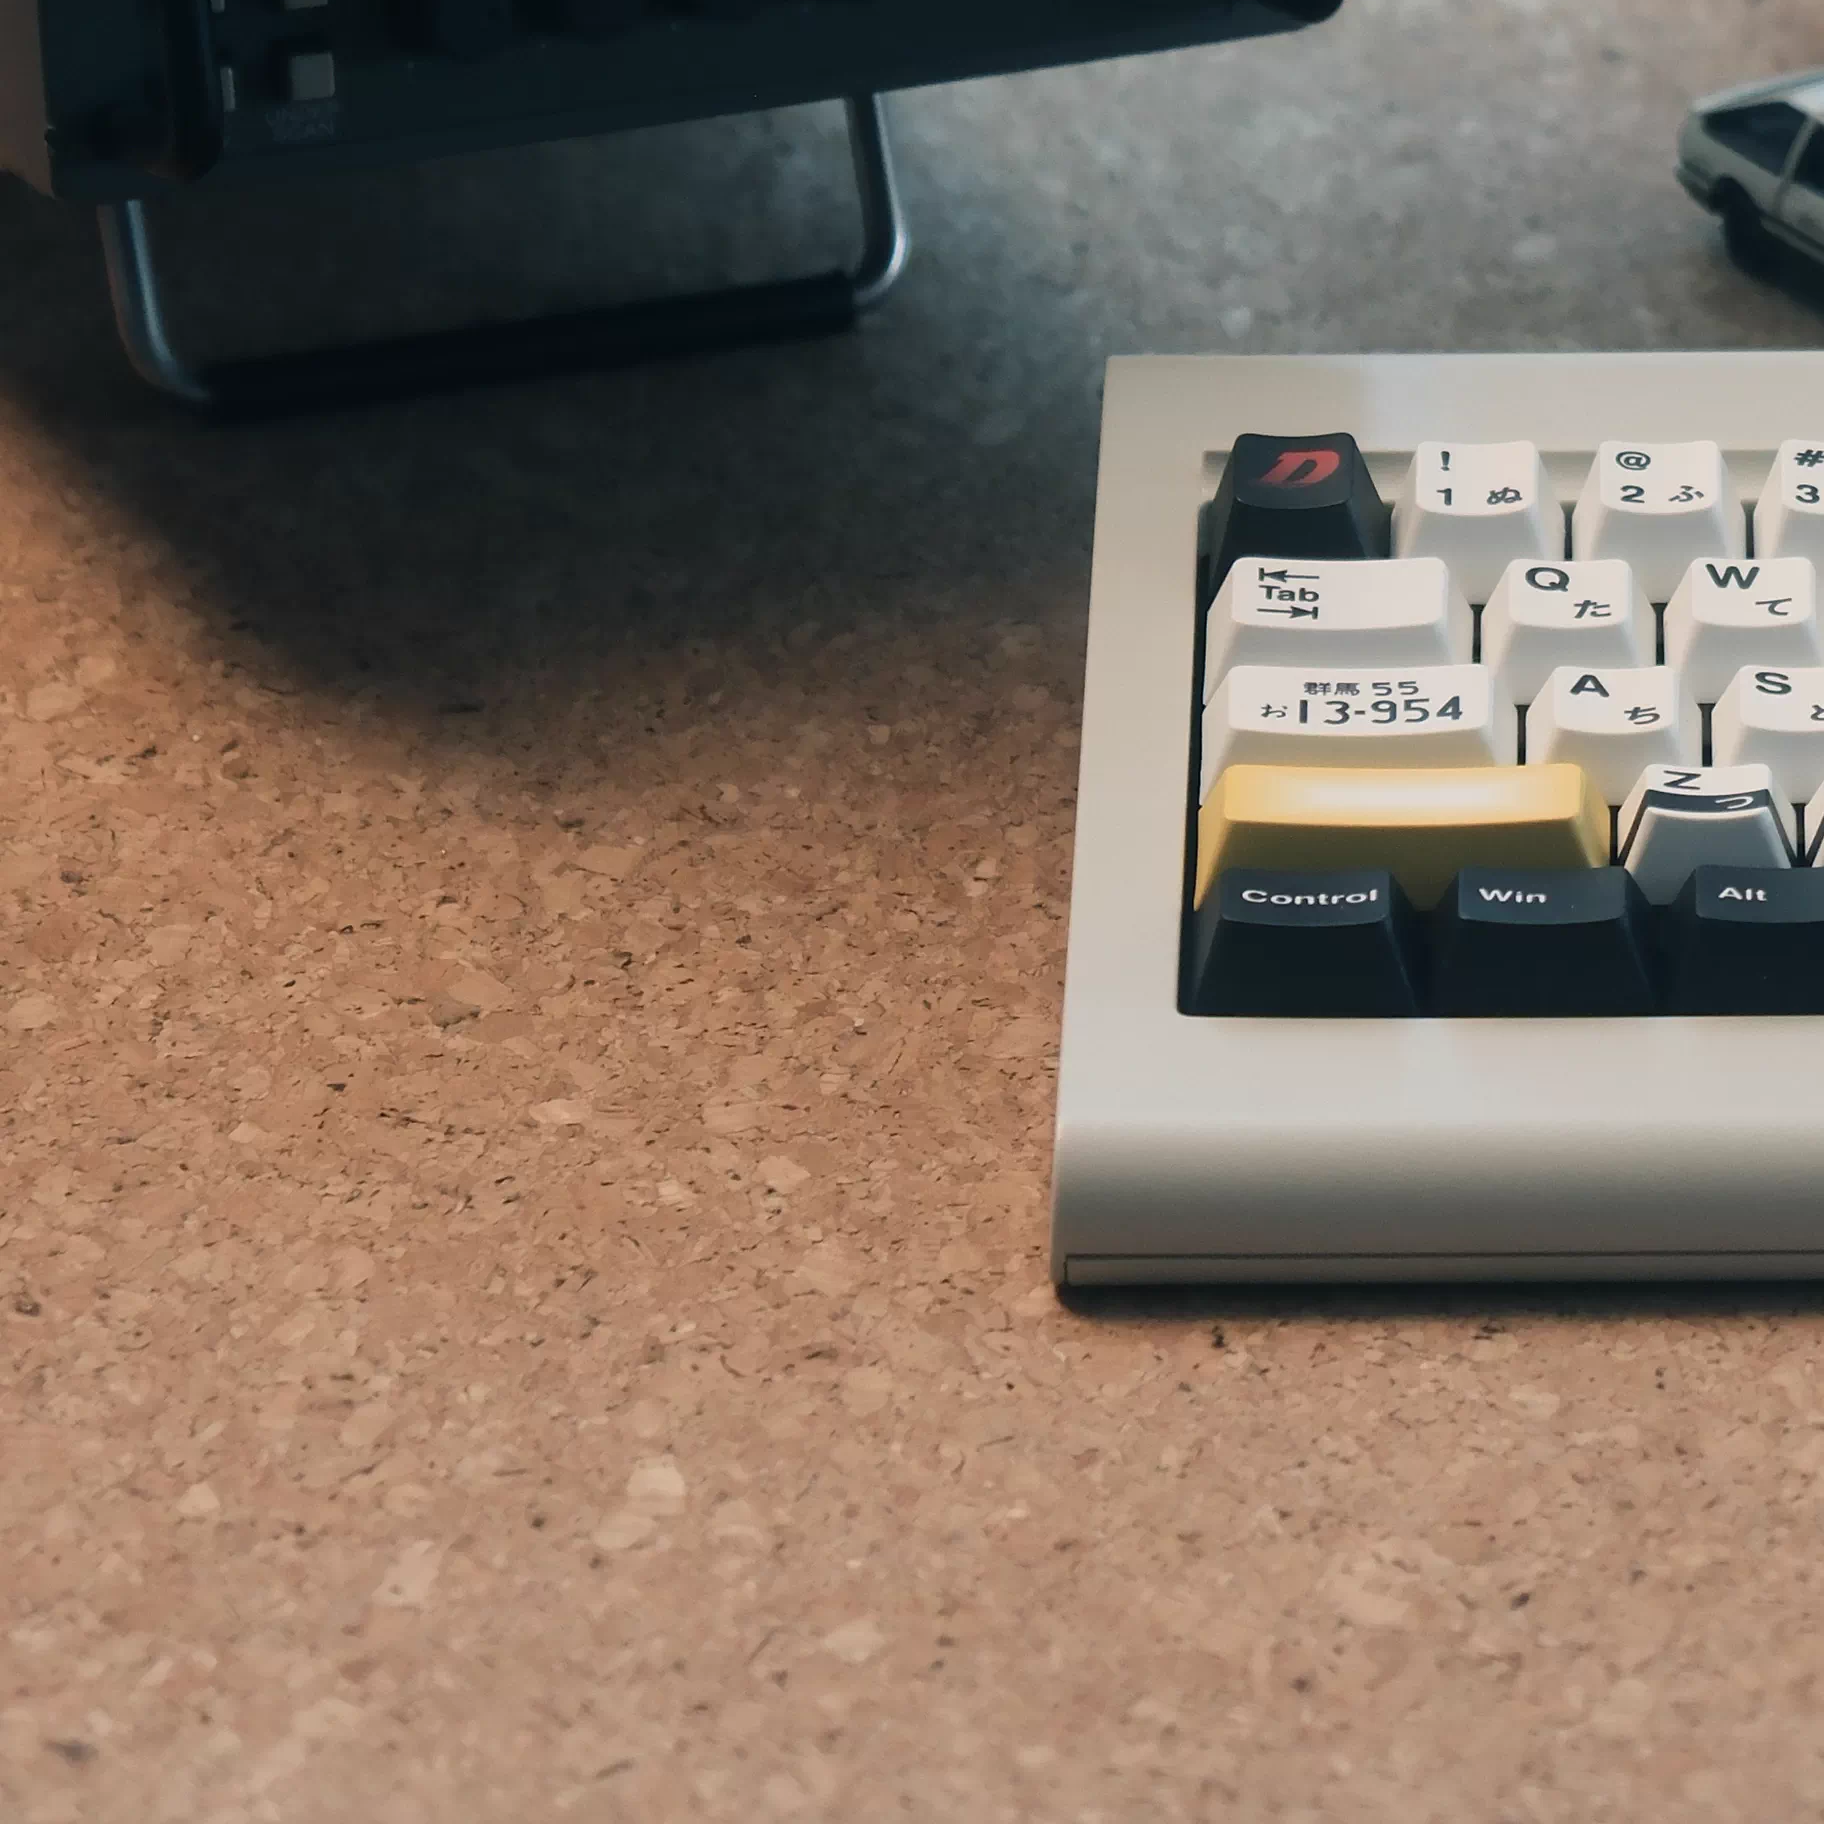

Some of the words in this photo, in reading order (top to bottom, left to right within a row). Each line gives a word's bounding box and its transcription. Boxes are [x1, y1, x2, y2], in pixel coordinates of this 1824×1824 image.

[1259, 449, 1341, 485] D
[1442, 451, 1450, 471] !
[1615, 451, 1651, 471] @
[1436, 487, 1453, 506] 1
[1486, 486, 1523, 505] ぬ
[1620, 485, 1645, 504] 2
[1668, 485, 1705, 503] ふ
[1795, 484, 1820, 504] 3
[1525, 566, 1570, 592] Q
[1705, 563, 1760, 590] W
[1258, 584, 1320, 603] Tab
[1573, 599, 1612, 619] た
[1755, 597, 1793, 616] て
[1303, 681, 1361, 697] 群馬
[1371, 680, 1419, 697] 55
[1570, 674, 1610, 698] A
[1754, 671, 1792, 695] S
[1261, 703, 1288, 718] お
[1299, 695, 1463, 725] 13-954
[1623, 706, 1661, 725] ち
[1663, 770, 1702, 791] Z
[1715, 795, 1754, 810] つ
[1242, 889, 1378, 905] Control
[1478, 888, 1546, 904] Win
[1718, 887, 1767, 901] Alt
